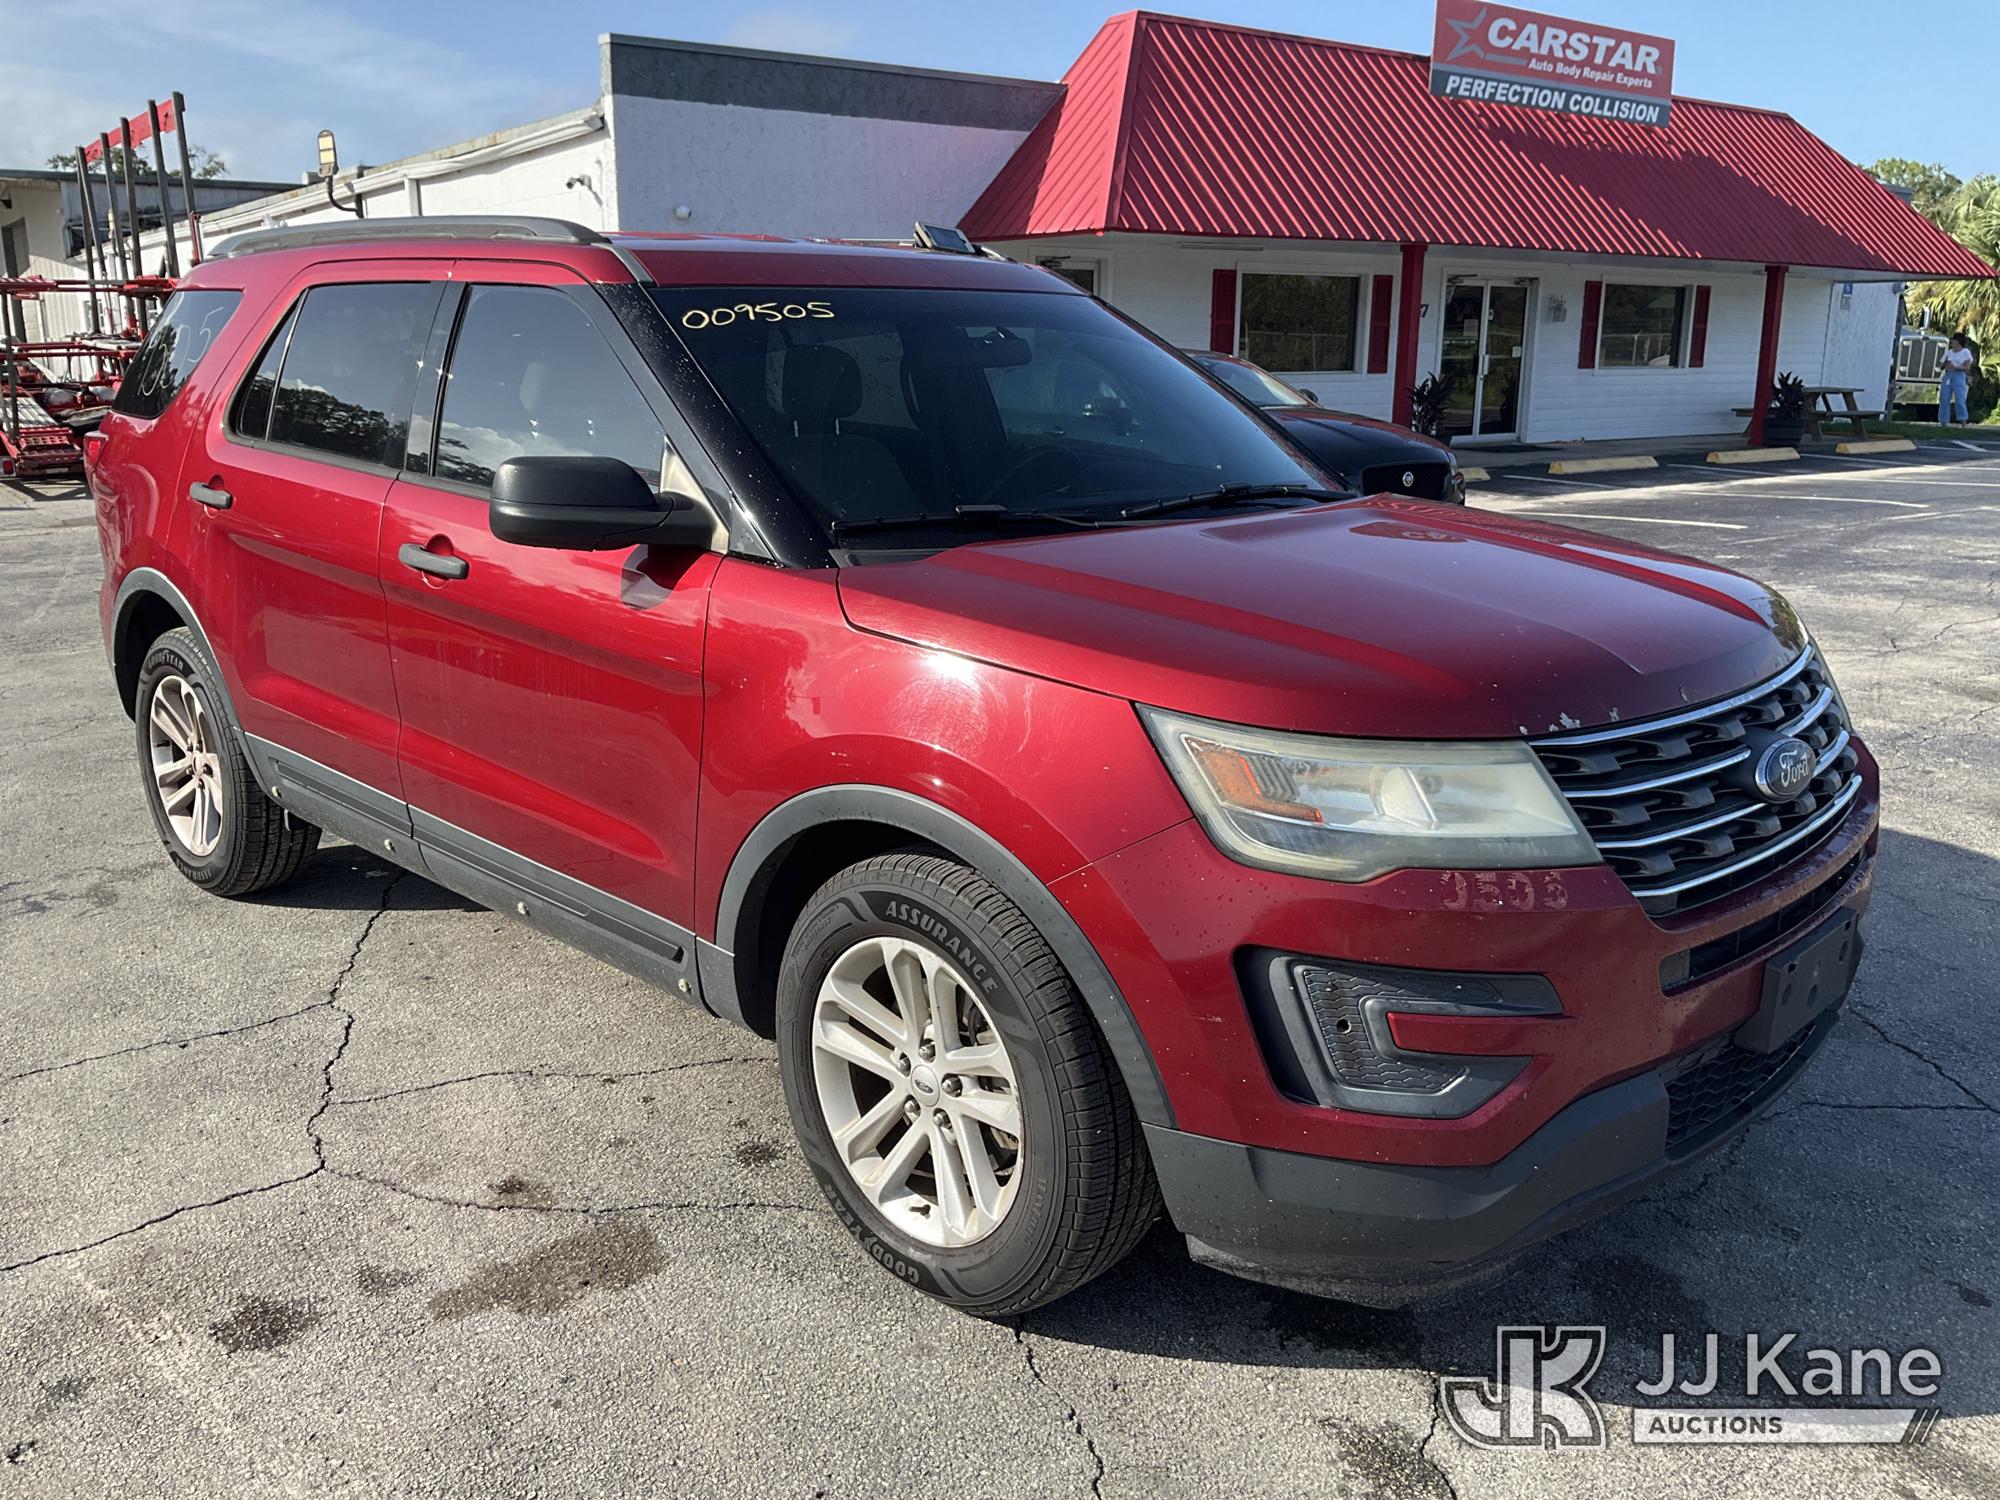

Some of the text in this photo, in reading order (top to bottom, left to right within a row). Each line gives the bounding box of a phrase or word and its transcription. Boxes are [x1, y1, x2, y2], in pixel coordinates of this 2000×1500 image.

[1487, 17, 1660, 74] CARSTAR
[1528, 58, 1653, 89] Auto Body Repair Experts
[1445, 75, 1660, 123] PERFECTION COLLISION
[682, 302, 835, 329] 009505
[1779, 749, 1810, 787] Ford
[885, 900, 999, 994] ASSURANCE
[824, 1183, 920, 1284] GOODYEAR
